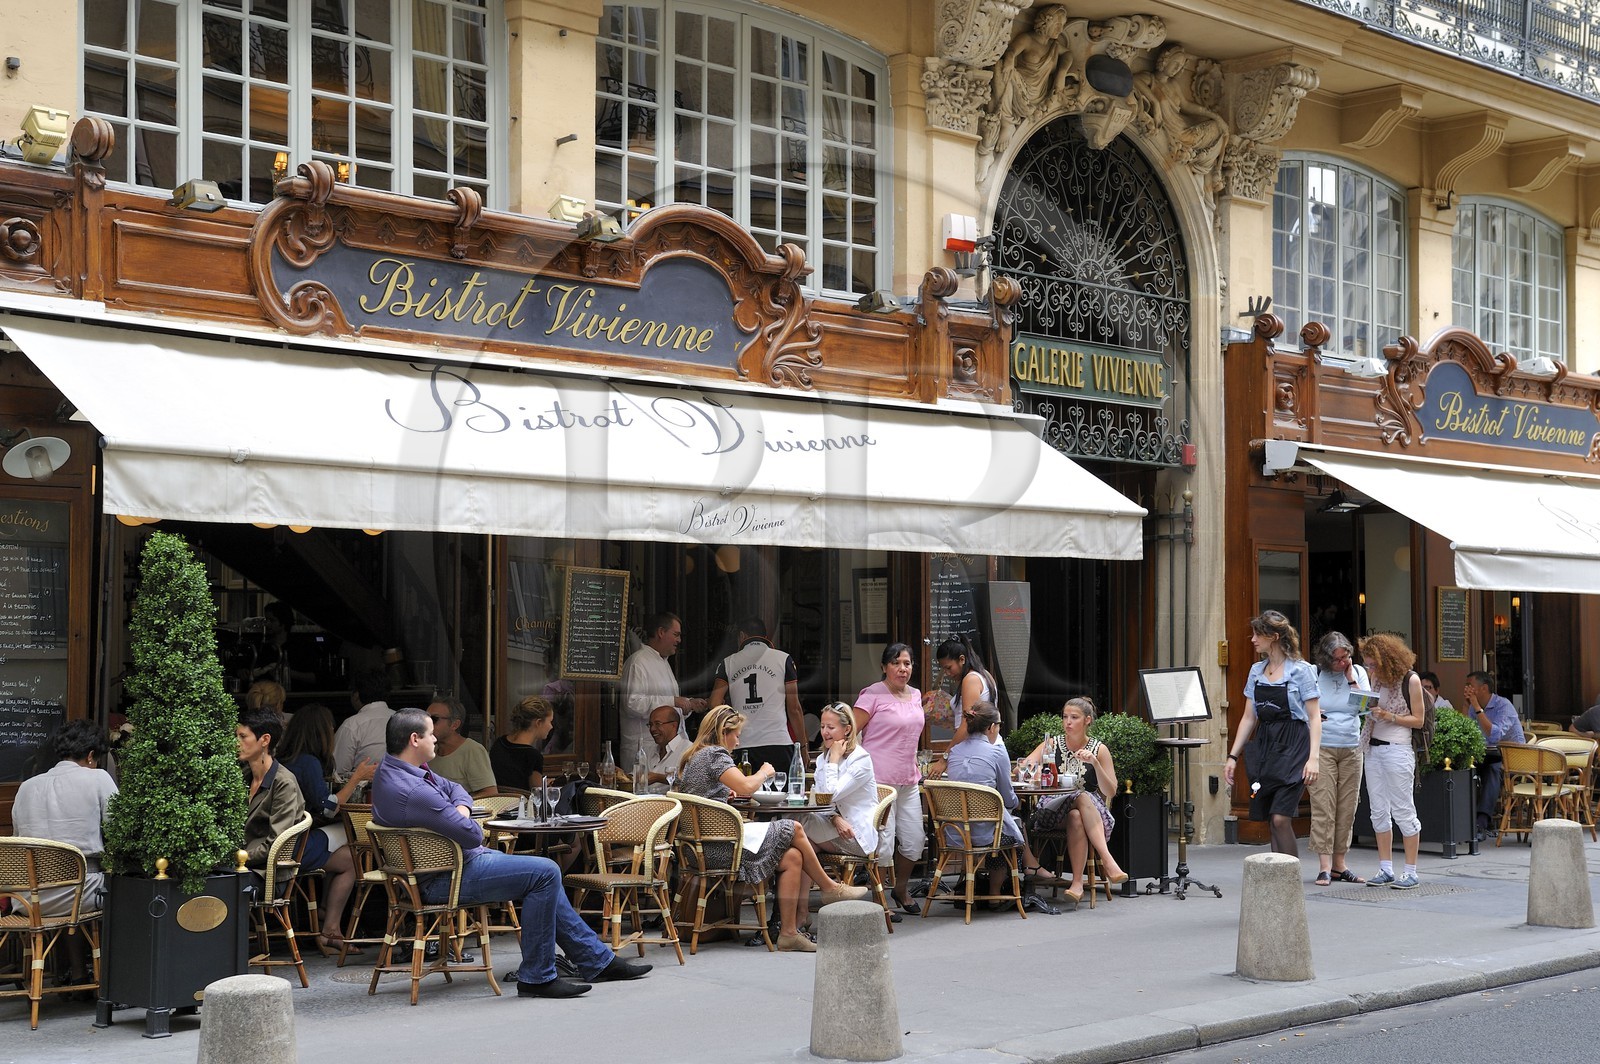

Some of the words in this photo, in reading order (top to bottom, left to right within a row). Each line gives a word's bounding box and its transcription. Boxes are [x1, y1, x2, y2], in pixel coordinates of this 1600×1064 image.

[359, 258, 541, 329] Bistrot
[545, 284, 715, 353] Vivienne
[1014, 342, 1085, 388] GALERIE
[1092, 353, 1165, 398] VIVIENNE
[384, 362, 633, 434] Bistrot
[610, 381, 877, 455] Vivienne
[1435, 391, 1510, 437] Bistrot
[1512, 404, 1586, 447] Vivienne
[679, 497, 730, 535] Bistrot
[732, 504, 786, 537] Vivienne
[743, 673, 763, 704] 1
